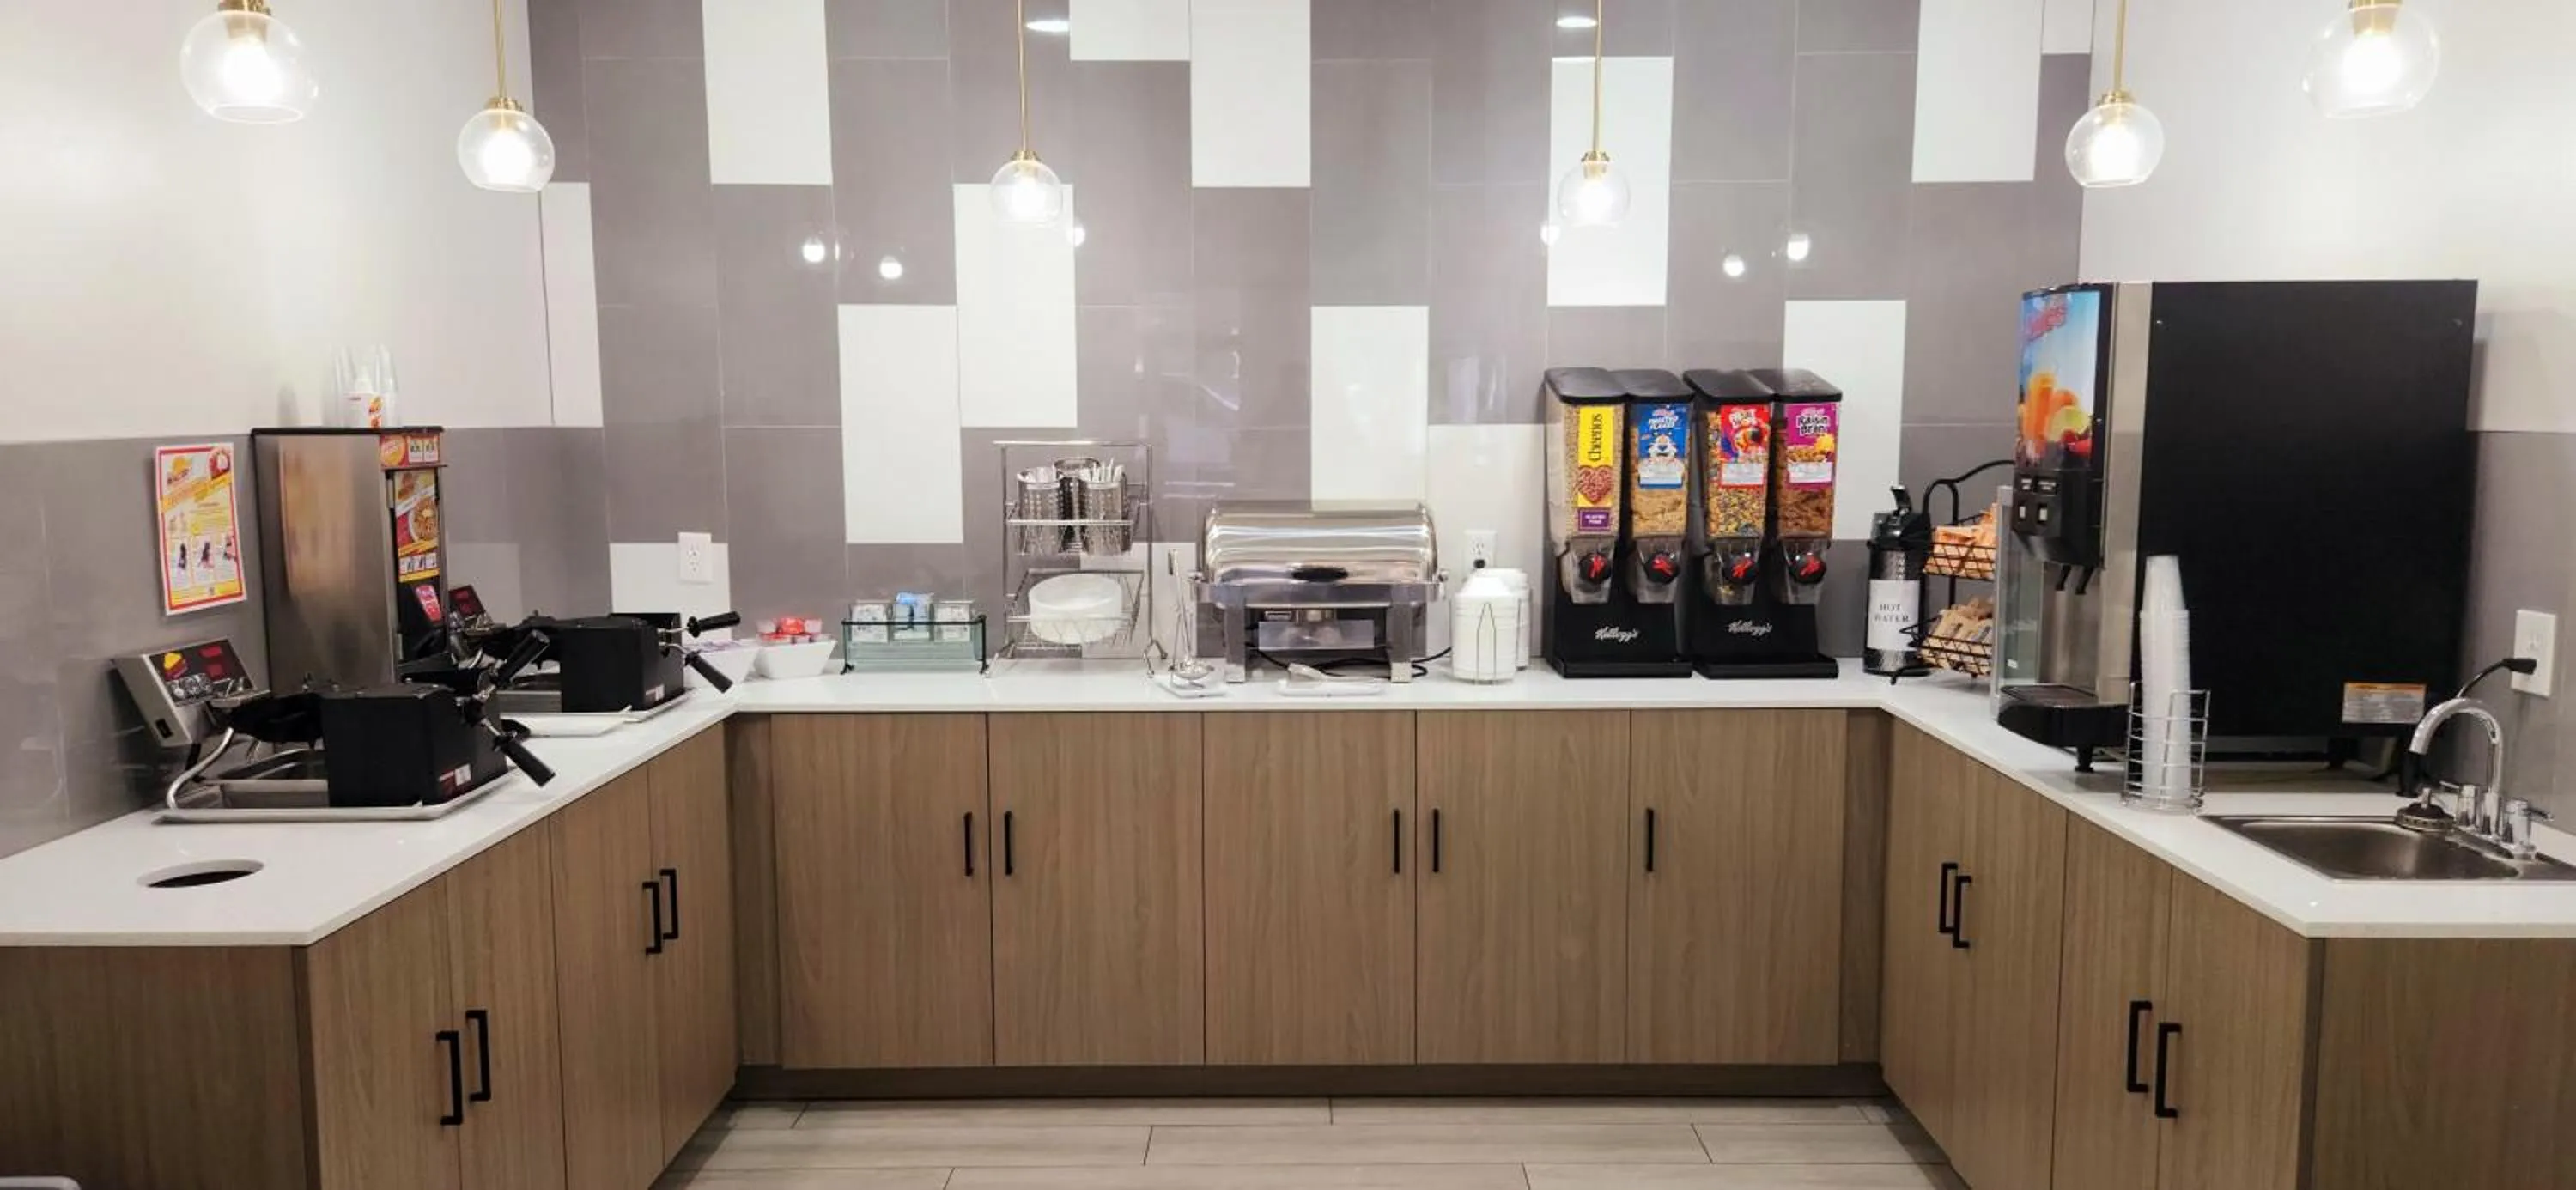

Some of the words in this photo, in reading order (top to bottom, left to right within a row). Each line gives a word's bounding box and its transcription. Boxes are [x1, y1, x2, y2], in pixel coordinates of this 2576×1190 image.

[1587, 413, 1602, 462] Cheerios
[1874, 614, 1911, 622] WATER
[1595, 626, 1640, 643] Kellogg's
[1728, 619, 1773, 636] Kellogg's
